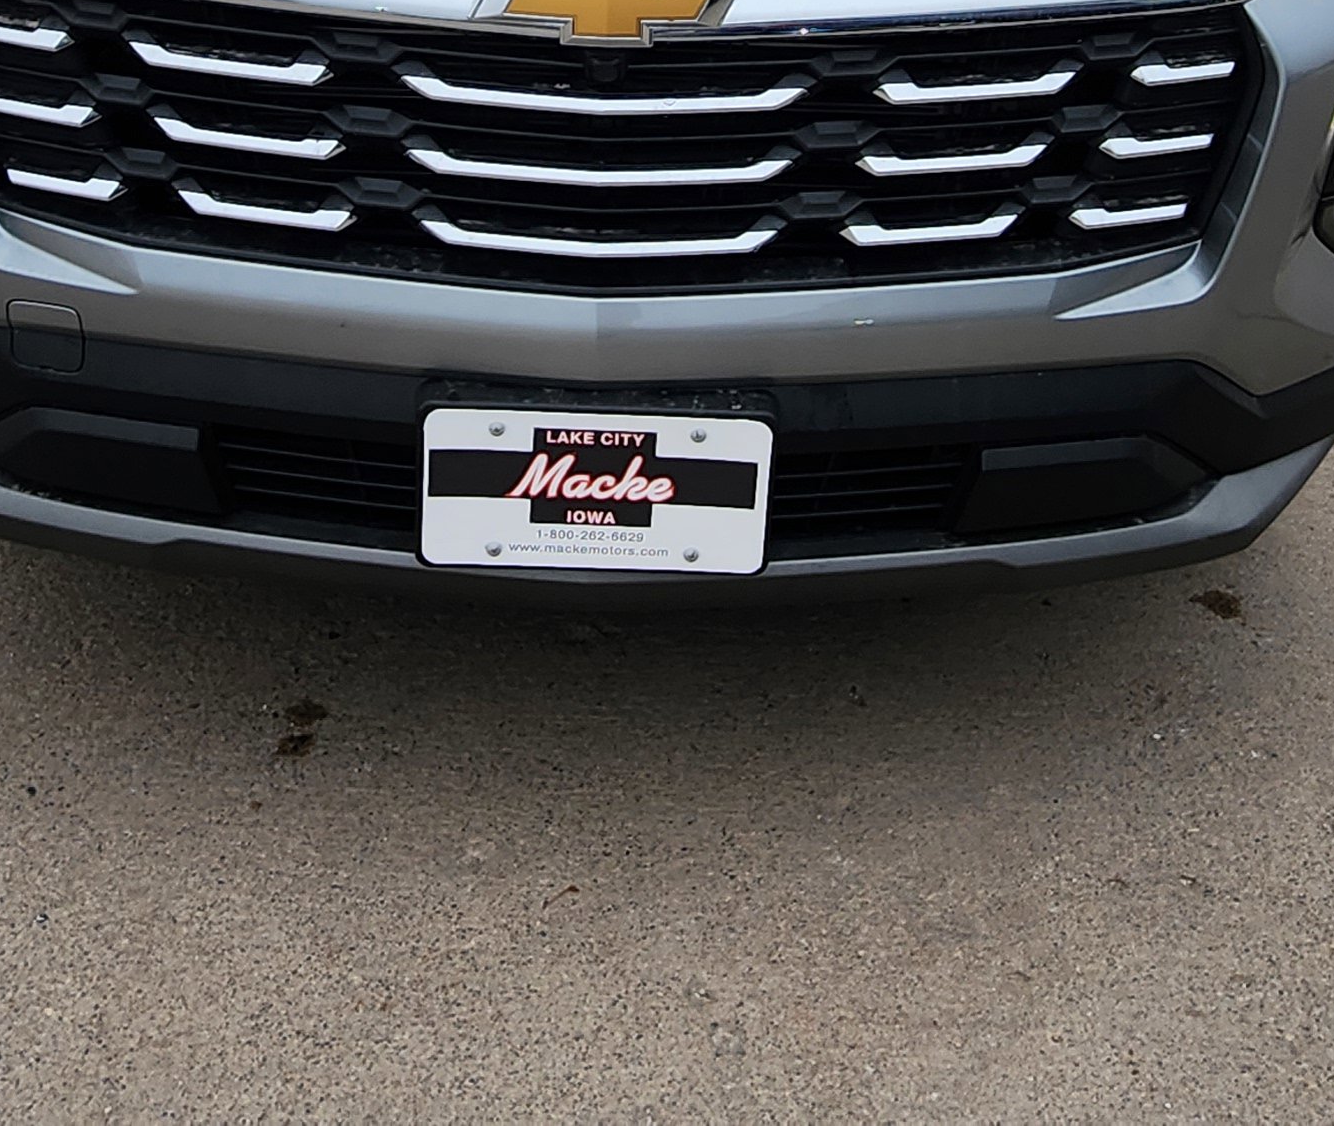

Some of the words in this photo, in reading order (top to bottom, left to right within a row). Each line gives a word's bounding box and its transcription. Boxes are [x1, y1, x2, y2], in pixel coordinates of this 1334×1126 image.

[545, 430, 595, 445] LAKE
[600, 432, 645, 447] CITY
[505, 452, 675, 502] Macke
[566, 510, 616, 524] IOWA
[537, 529, 645, 543] 1-800-262-6629
[508, 542, 669, 557] www.mackemotors.com
